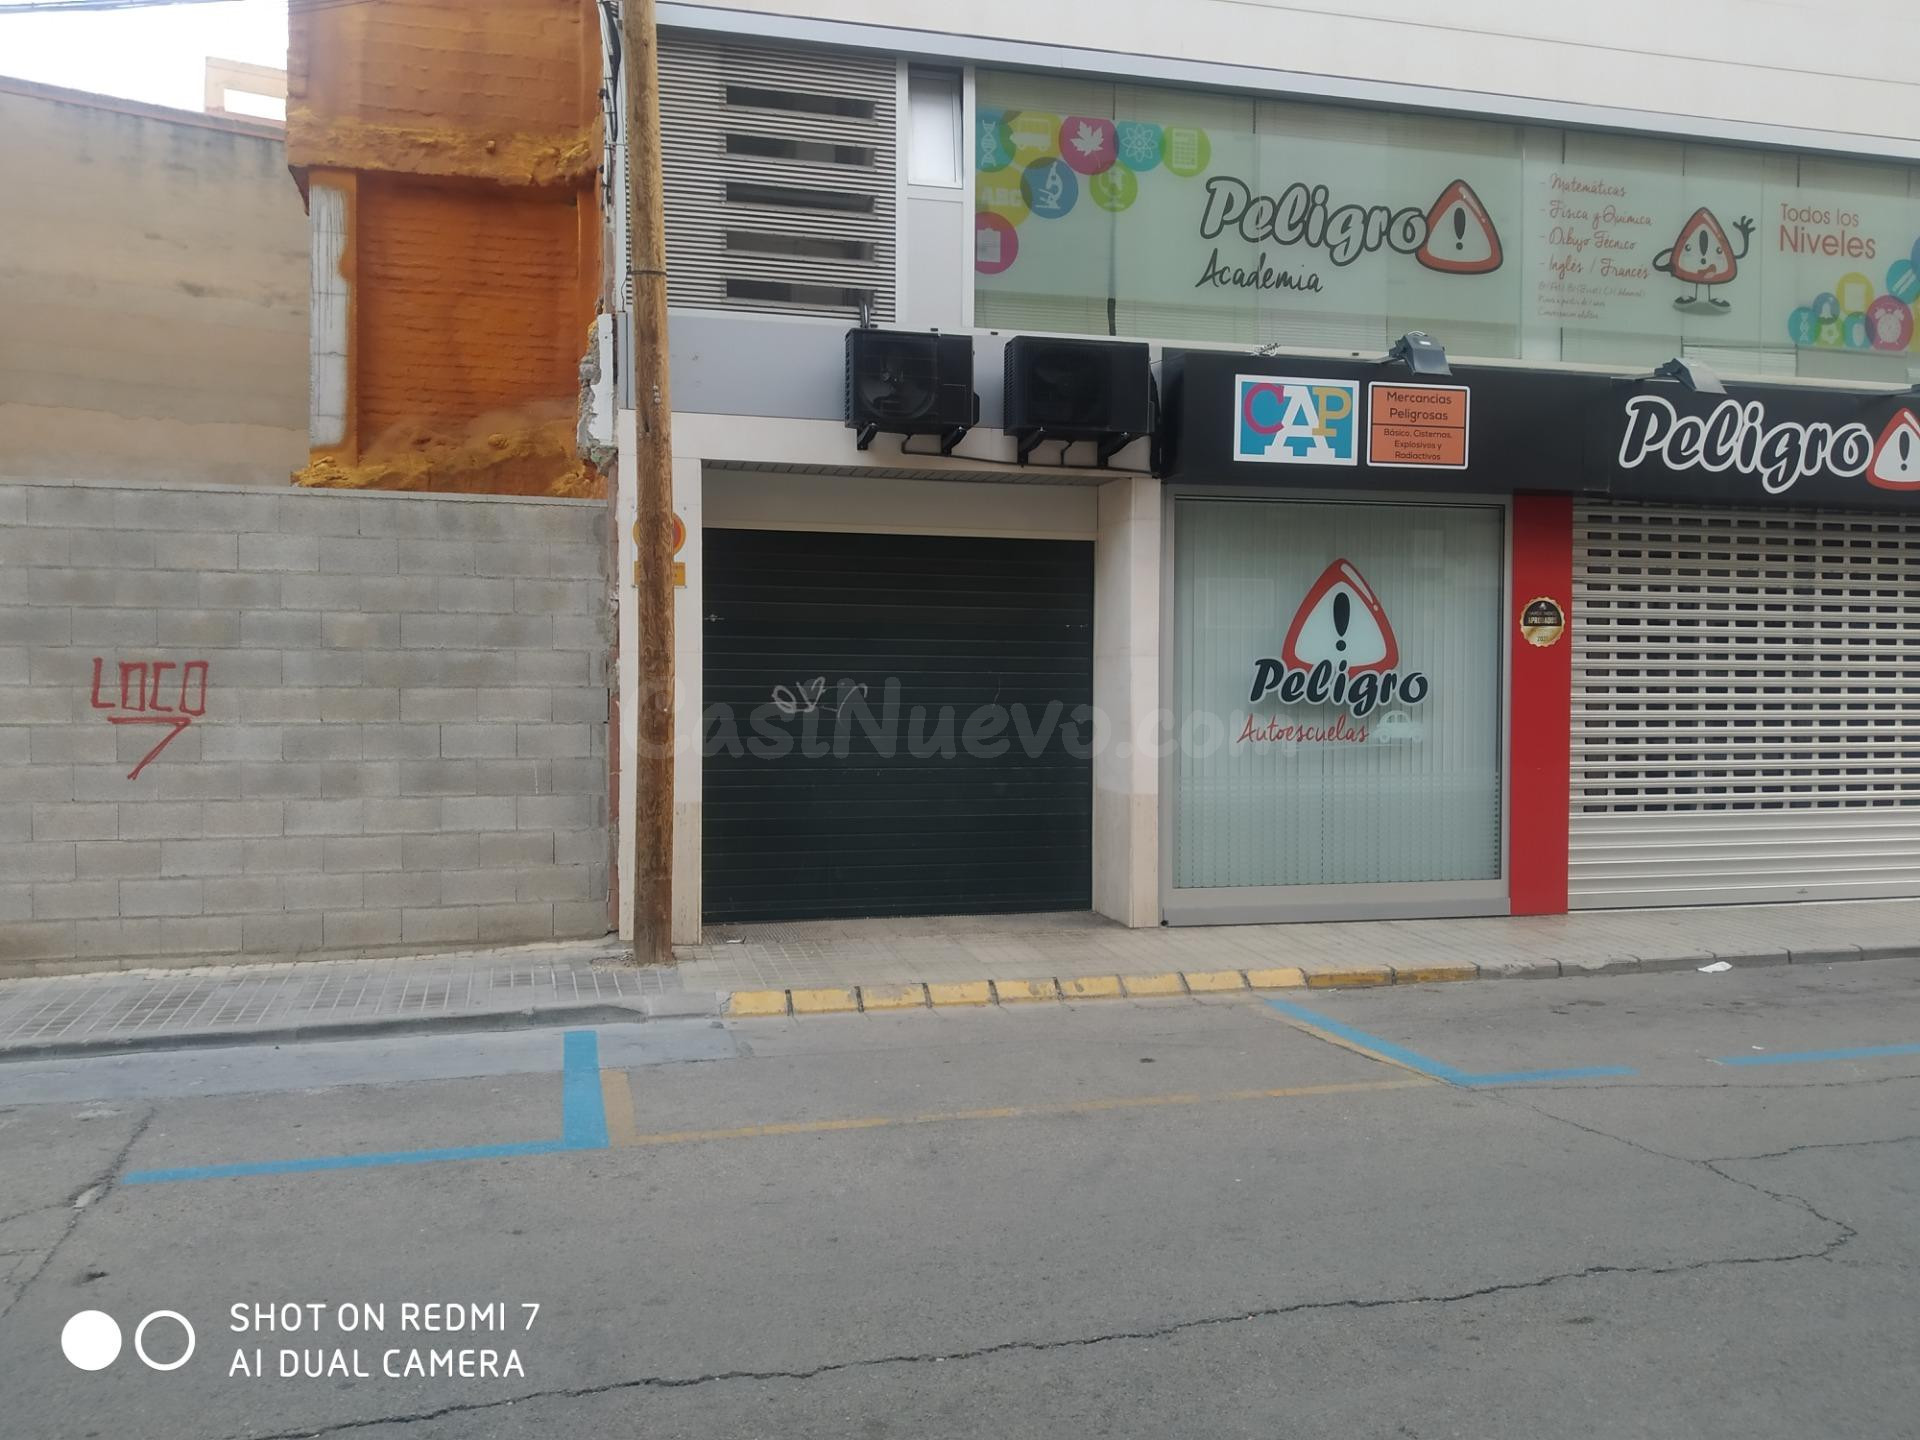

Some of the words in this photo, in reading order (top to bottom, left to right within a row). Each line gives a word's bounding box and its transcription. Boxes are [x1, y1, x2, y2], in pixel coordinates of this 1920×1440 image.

[1200, 176, 1429, 267] Peligro
[1780, 202, 1831, 225] Todos
[1836, 207, 1859, 228] los
[1549, 226, 1591, 252] Dibujo
[1780, 224, 1877, 260] Niveles
[1195, 248, 1324, 293] Academia
[1244, 382, 1352, 458] CAP
[1389, 407, 1448, 423] Peligrosas
[1394, 440, 1436, 450] Explosivos
[1437, 443, 1442, 451] y
[1394, 451, 1441, 460] Radiactivos
[1619, 395, 1874, 494] Peligro
[90, 657, 209, 716] LOCO
[1249, 657, 1429, 718] Peligro
[1236, 713, 1370, 743] Autoescuelas
